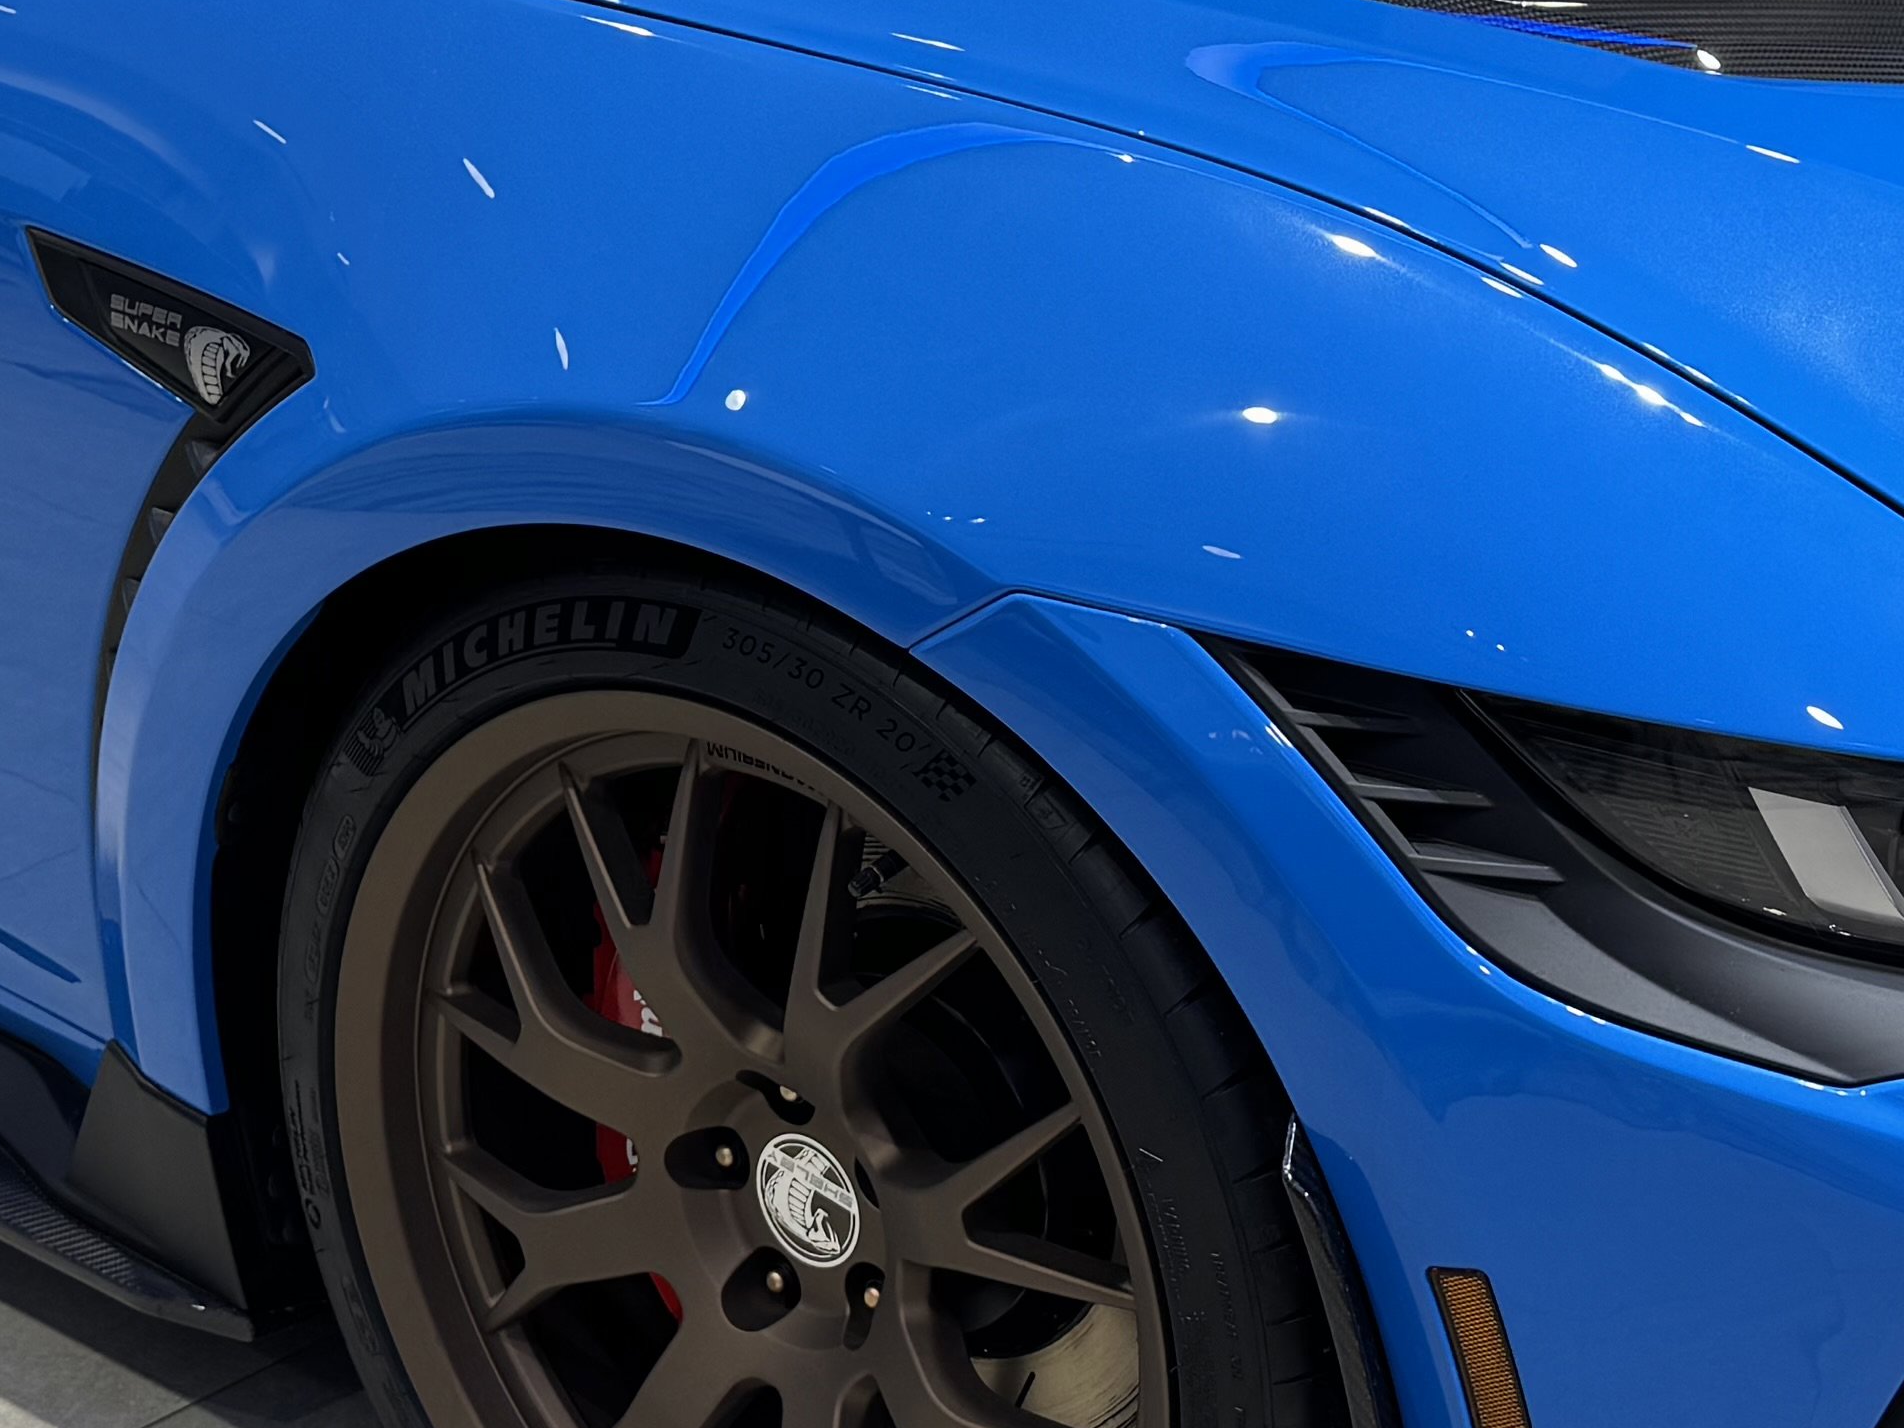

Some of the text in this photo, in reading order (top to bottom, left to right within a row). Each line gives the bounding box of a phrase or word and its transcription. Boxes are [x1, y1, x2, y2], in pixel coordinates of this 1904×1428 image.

[110, 293, 183, 329] SUPER
[110, 310, 181, 347] SNAKE
[402, 600, 678, 717] MICHELIN
[722, 627, 825, 689] 305/30
[831, 683, 872, 721] ZR
[876, 719, 916, 753] 20
[767, 1150, 853, 1209] SHELBY
